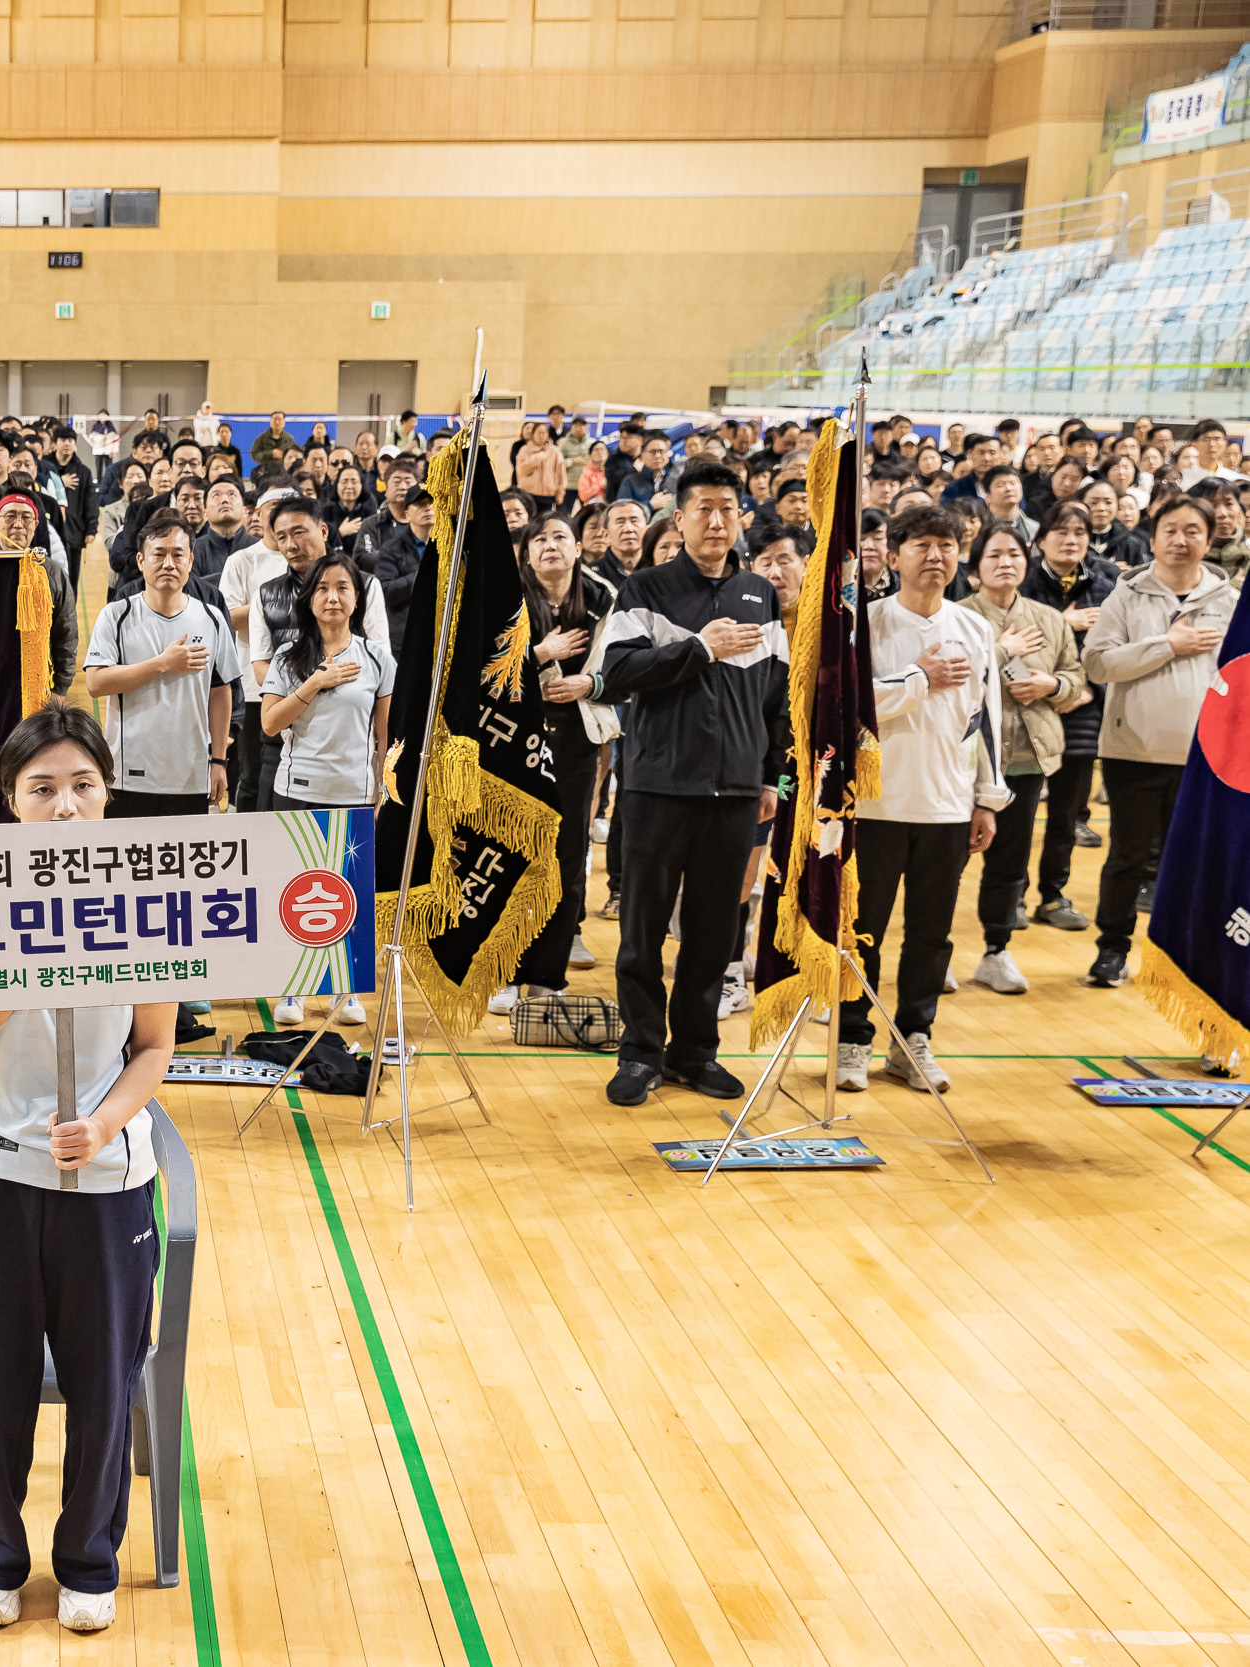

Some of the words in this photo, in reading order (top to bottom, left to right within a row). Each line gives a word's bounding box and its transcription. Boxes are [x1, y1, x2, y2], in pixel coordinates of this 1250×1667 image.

[28, 838, 249, 886] 광진구협회장기
[292, 880, 344, 934] 승
[37, 958, 209, 989] 광진구배드민턴협회
